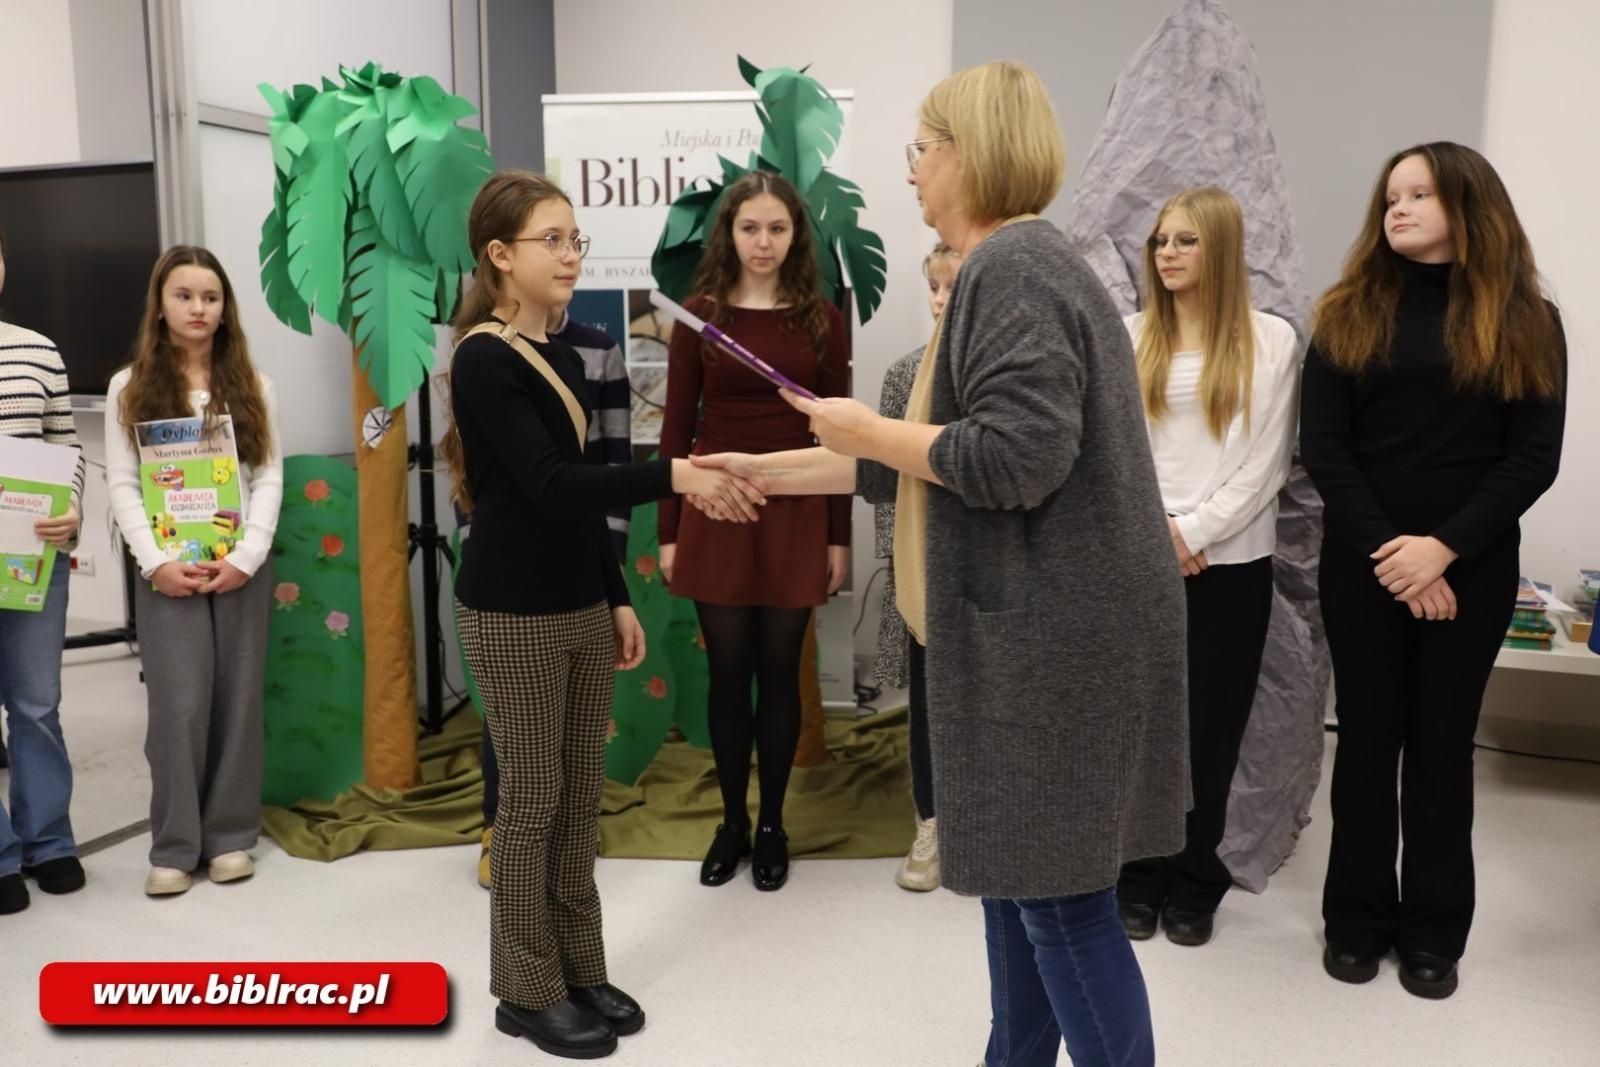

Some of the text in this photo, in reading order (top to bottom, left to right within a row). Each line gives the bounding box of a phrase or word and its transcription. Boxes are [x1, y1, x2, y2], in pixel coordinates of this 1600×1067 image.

[660, 127, 761, 152] Miejska i Po
[576, 156, 713, 208] Bibli
